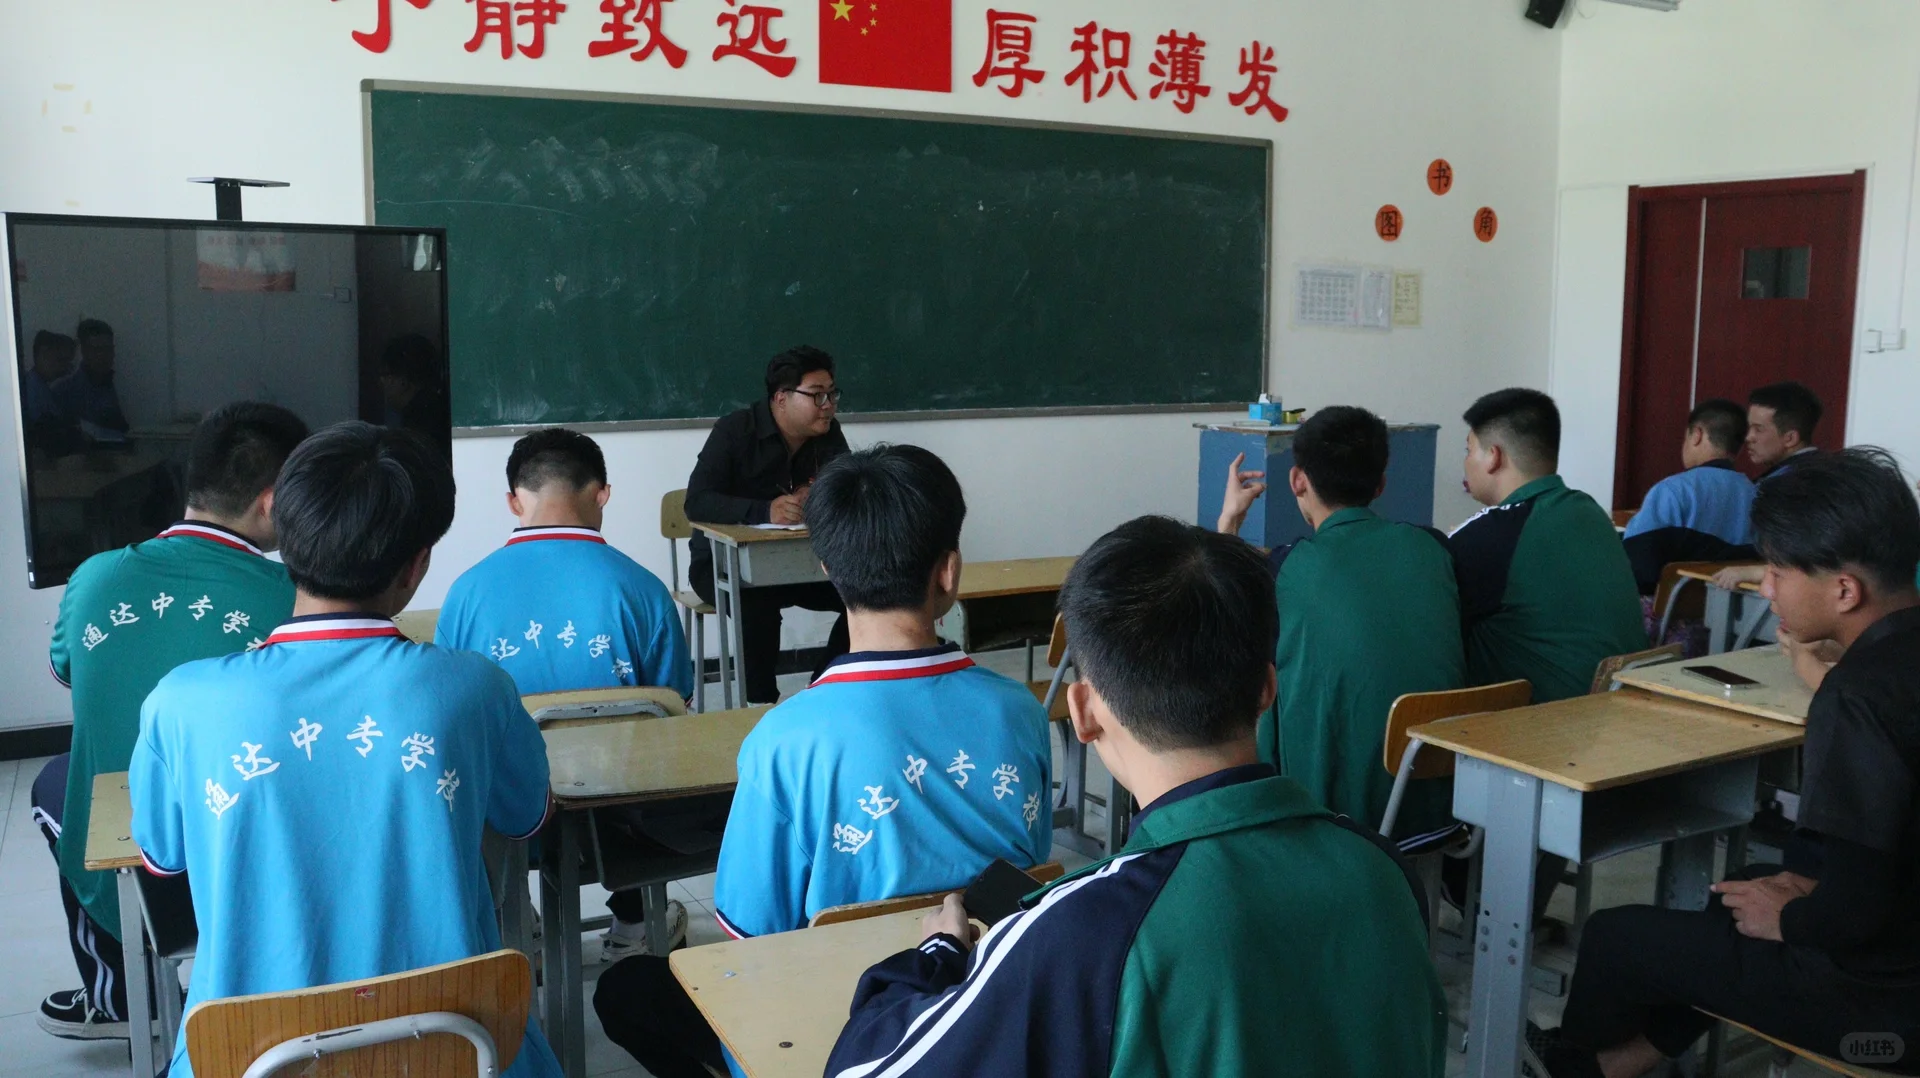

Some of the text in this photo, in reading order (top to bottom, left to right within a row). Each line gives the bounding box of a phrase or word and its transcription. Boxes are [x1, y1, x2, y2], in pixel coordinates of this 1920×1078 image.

[972, 8, 1289, 122] 厚积薄发
[205, 715, 460, 812] 通达中专学校
[833, 750, 1040, 855] 通达中专学校
